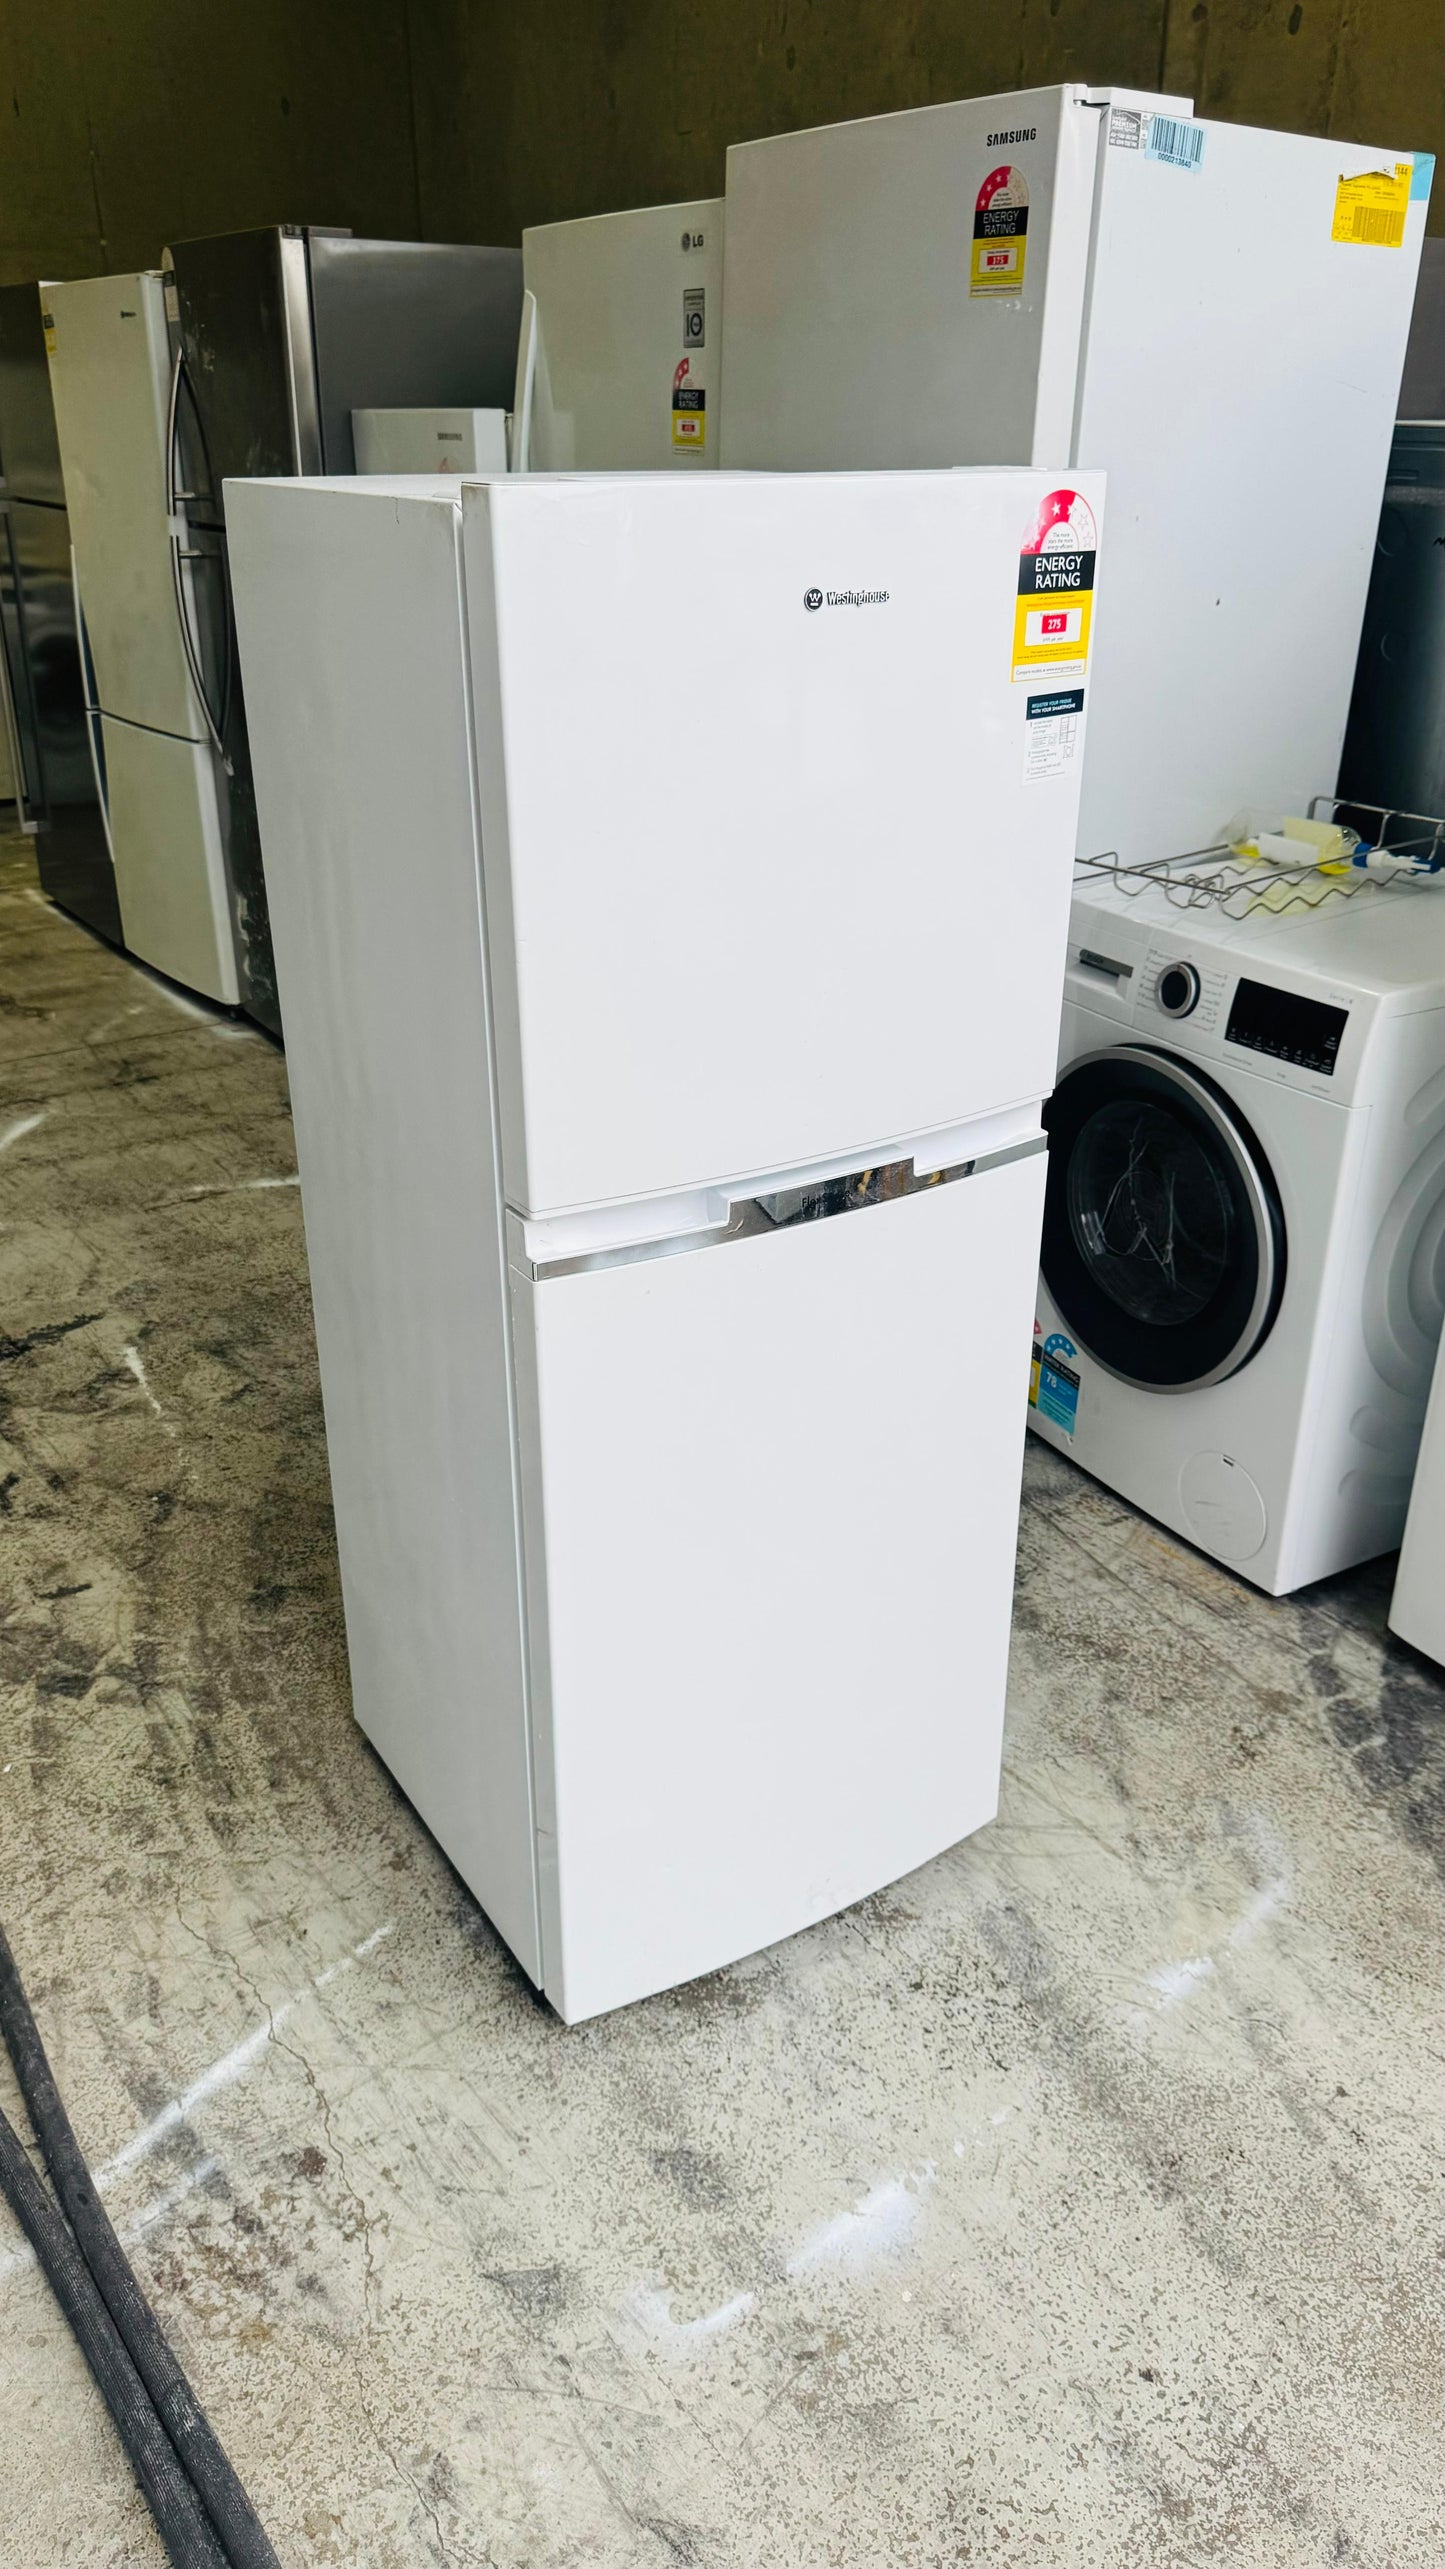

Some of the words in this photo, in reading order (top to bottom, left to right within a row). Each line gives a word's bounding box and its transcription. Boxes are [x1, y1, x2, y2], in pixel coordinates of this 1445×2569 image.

[986, 128, 1037, 146] SAMSUNG
[983, 210, 1020, 224] ENERGY
[984, 223, 1016, 236] RATING
[692, 234, 704, 248] LG
[1035, 555, 1083, 572] ENERGY
[1035, 572, 1081, 589] RATING
[826, 590, 890, 606] Westinghouse
[1047, 618, 1062, 630] 275
